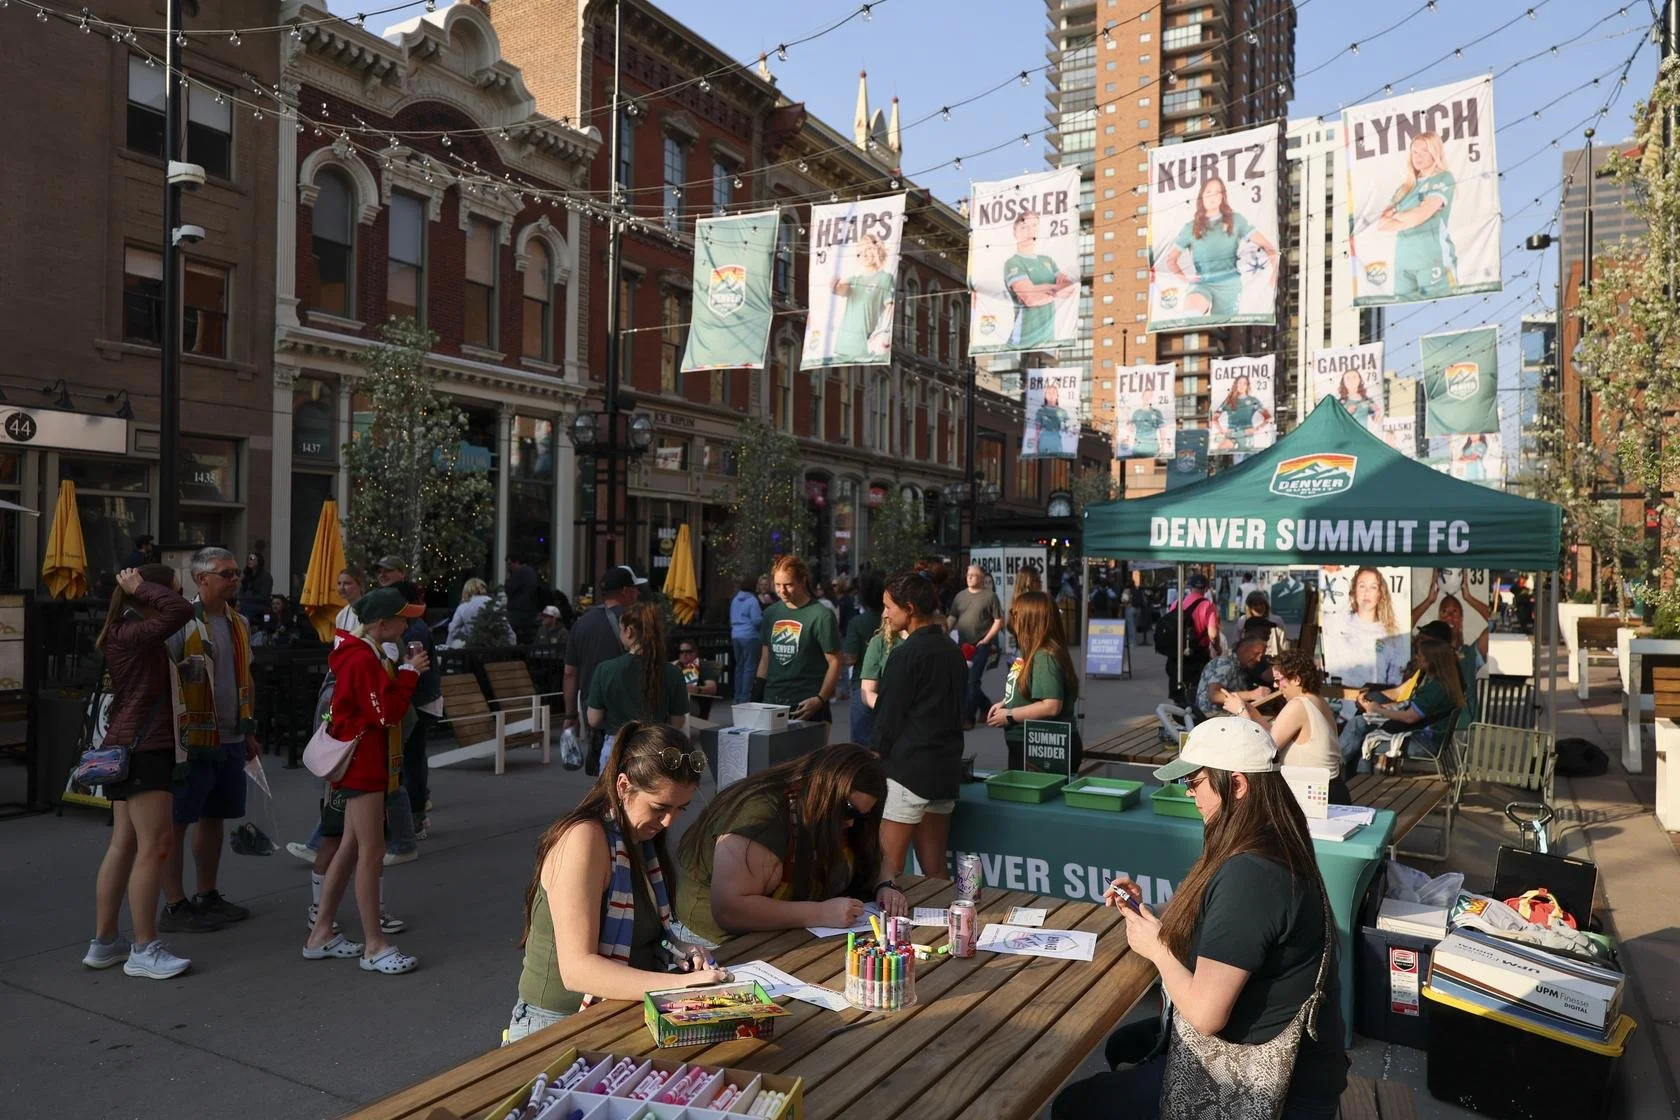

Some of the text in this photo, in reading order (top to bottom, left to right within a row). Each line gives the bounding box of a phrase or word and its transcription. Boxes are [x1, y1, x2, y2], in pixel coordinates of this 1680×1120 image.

[1354, 97, 1479, 161] LYNCH
[1468, 142, 1481, 162] 5
[1157, 143, 1265, 194] KURTZ
[1251, 184, 1262, 203] 3
[979, 189, 1069, 227] KÖSSLER
[816, 210, 893, 249] HEAPS
[1049, 218, 1069, 239] 25
[1215, 363, 1269, 380] GAETINO
[1317, 352, 1377, 374] GARCIA
[1119, 371, 1170, 393] FLINT
[1256, 380, 1268, 391] 23
[1366, 371, 1377, 382] 79
[9, 419, 32, 437] 44
[302, 442, 321, 453] 1437
[194, 471, 216, 484] 1435
[1278, 478, 1344, 491] DENVER
[1150, 516, 1470, 554] DENVER SUMMIT FC
[1389, 575, 1404, 594] 17
[1470, 568, 1484, 586] 33
[772, 643, 796, 654] DENVER
[1028, 731, 1068, 746] SUMMIT
[1028, 744, 1066, 760] INSIDER
[913, 848, 1051, 893] VER
[1535, 984, 1590, 1008] UPM Finesse
[1563, 1001, 1588, 1015] DIGITAL
